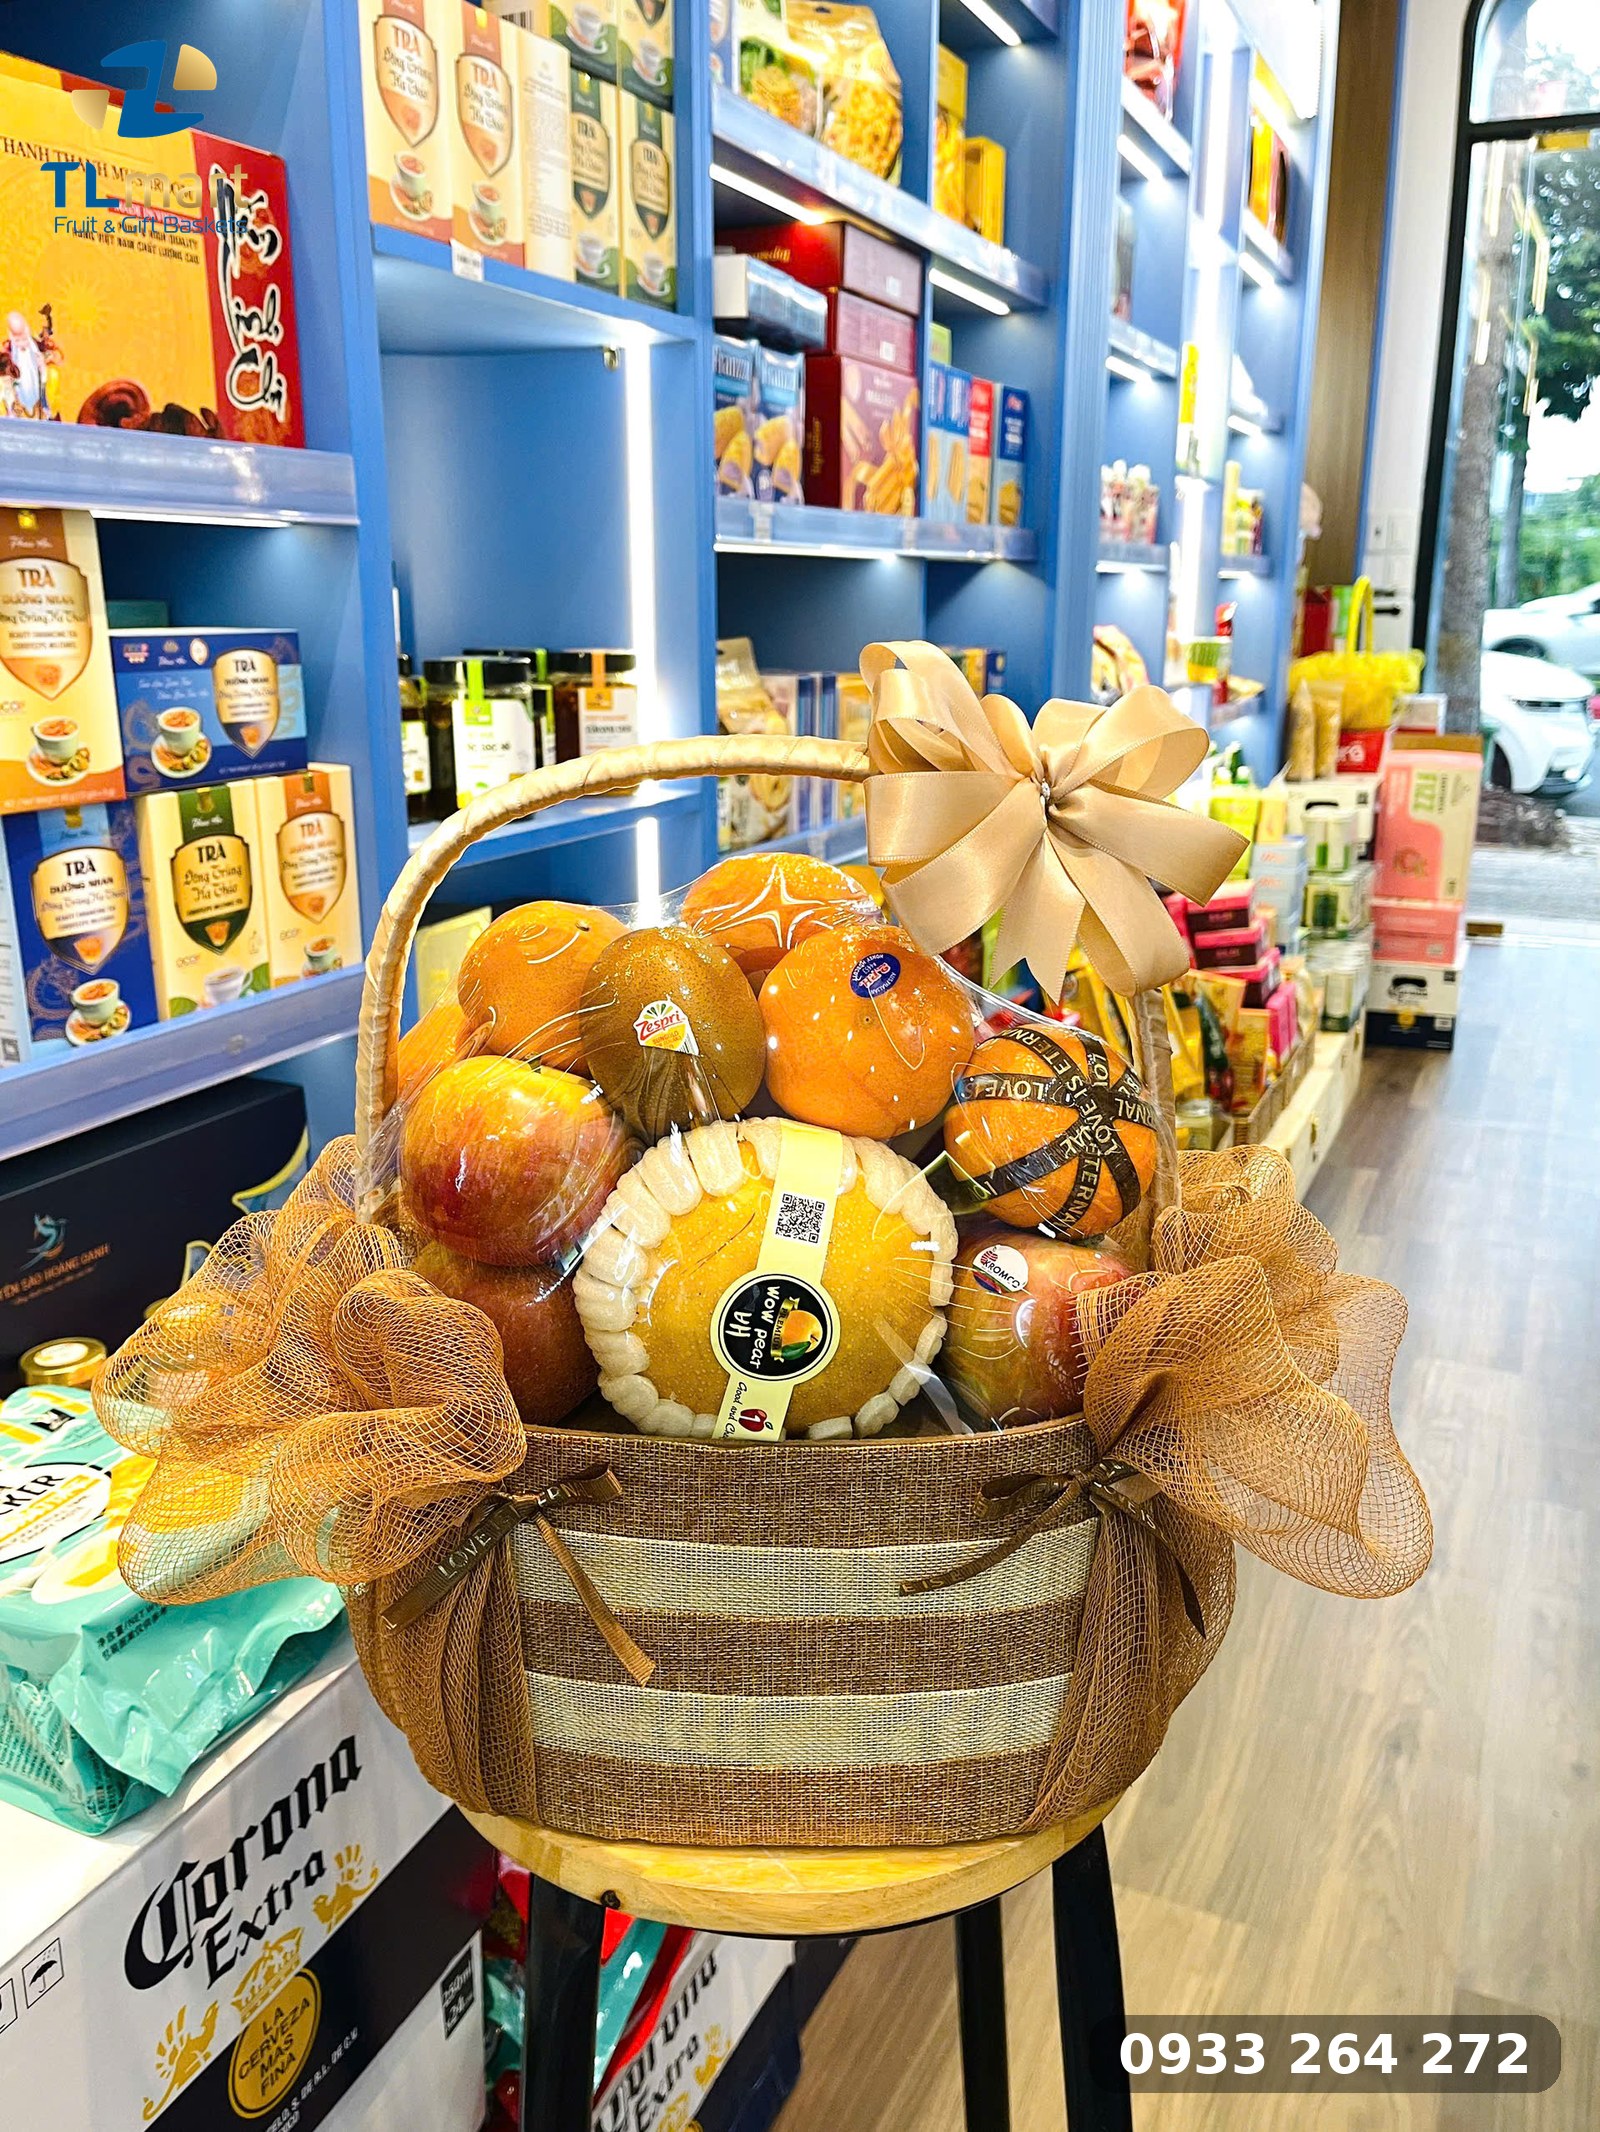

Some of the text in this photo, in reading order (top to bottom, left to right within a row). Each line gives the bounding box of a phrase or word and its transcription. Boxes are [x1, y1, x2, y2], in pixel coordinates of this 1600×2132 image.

[64, 855, 97, 877] TRÀ
[195, 839, 227, 863] TRÀ
[636, 1010, 681, 1041] Zespri
[983, 1259, 1021, 1289] KROMCO
[733, 1381, 747, 1405] Good
[437, 1530, 493, 1578] LOVE
[123, 1734, 363, 1991] Corona
[205, 1848, 327, 1990] Extra
[238, 1996, 311, 2080] CERVEZA
[261, 2006, 285, 2037] LA
[260, 2032, 294, 2079] MAS
[260, 2051, 297, 2097] FINA
